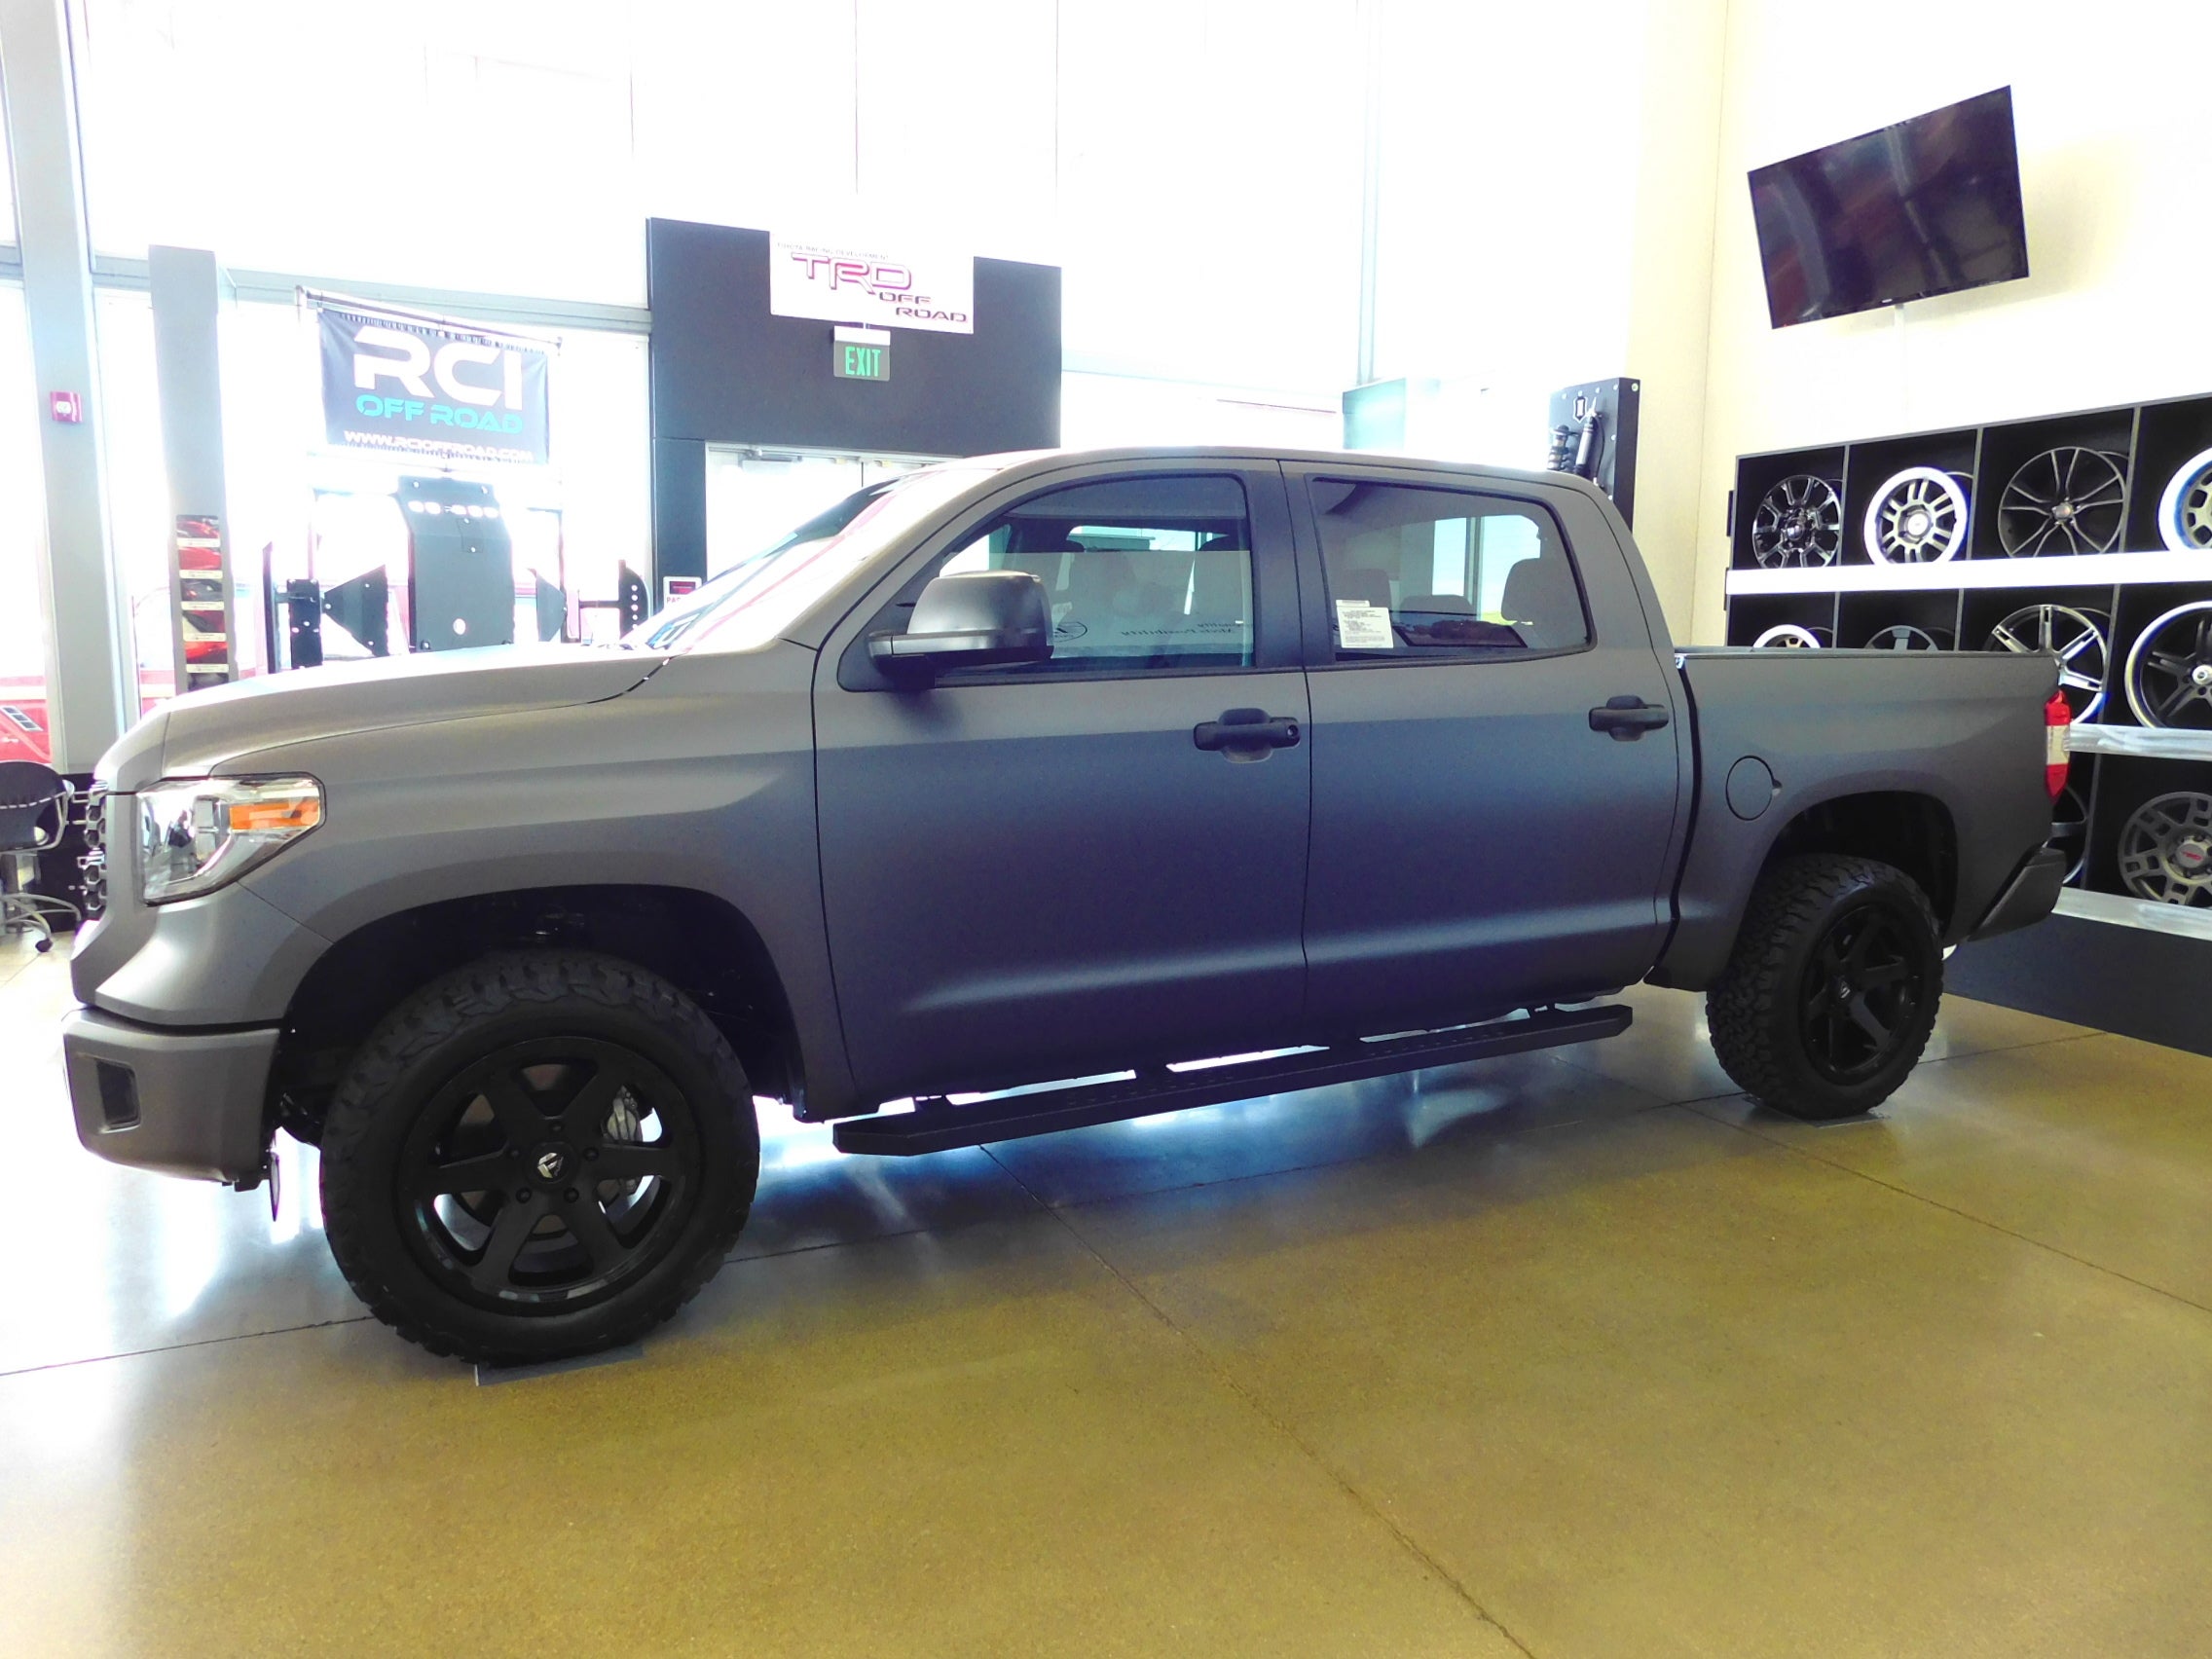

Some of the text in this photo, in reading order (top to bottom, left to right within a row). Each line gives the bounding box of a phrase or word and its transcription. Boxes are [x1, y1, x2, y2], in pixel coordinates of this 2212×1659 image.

[791, 252, 911, 295] TRD
[879, 292, 932, 305] OFF
[895, 307, 967, 323] ROAD
[353, 325, 523, 411] RCI
[845, 346, 881, 377] EXIT
[355, 394, 523, 434] OFF ROAD
